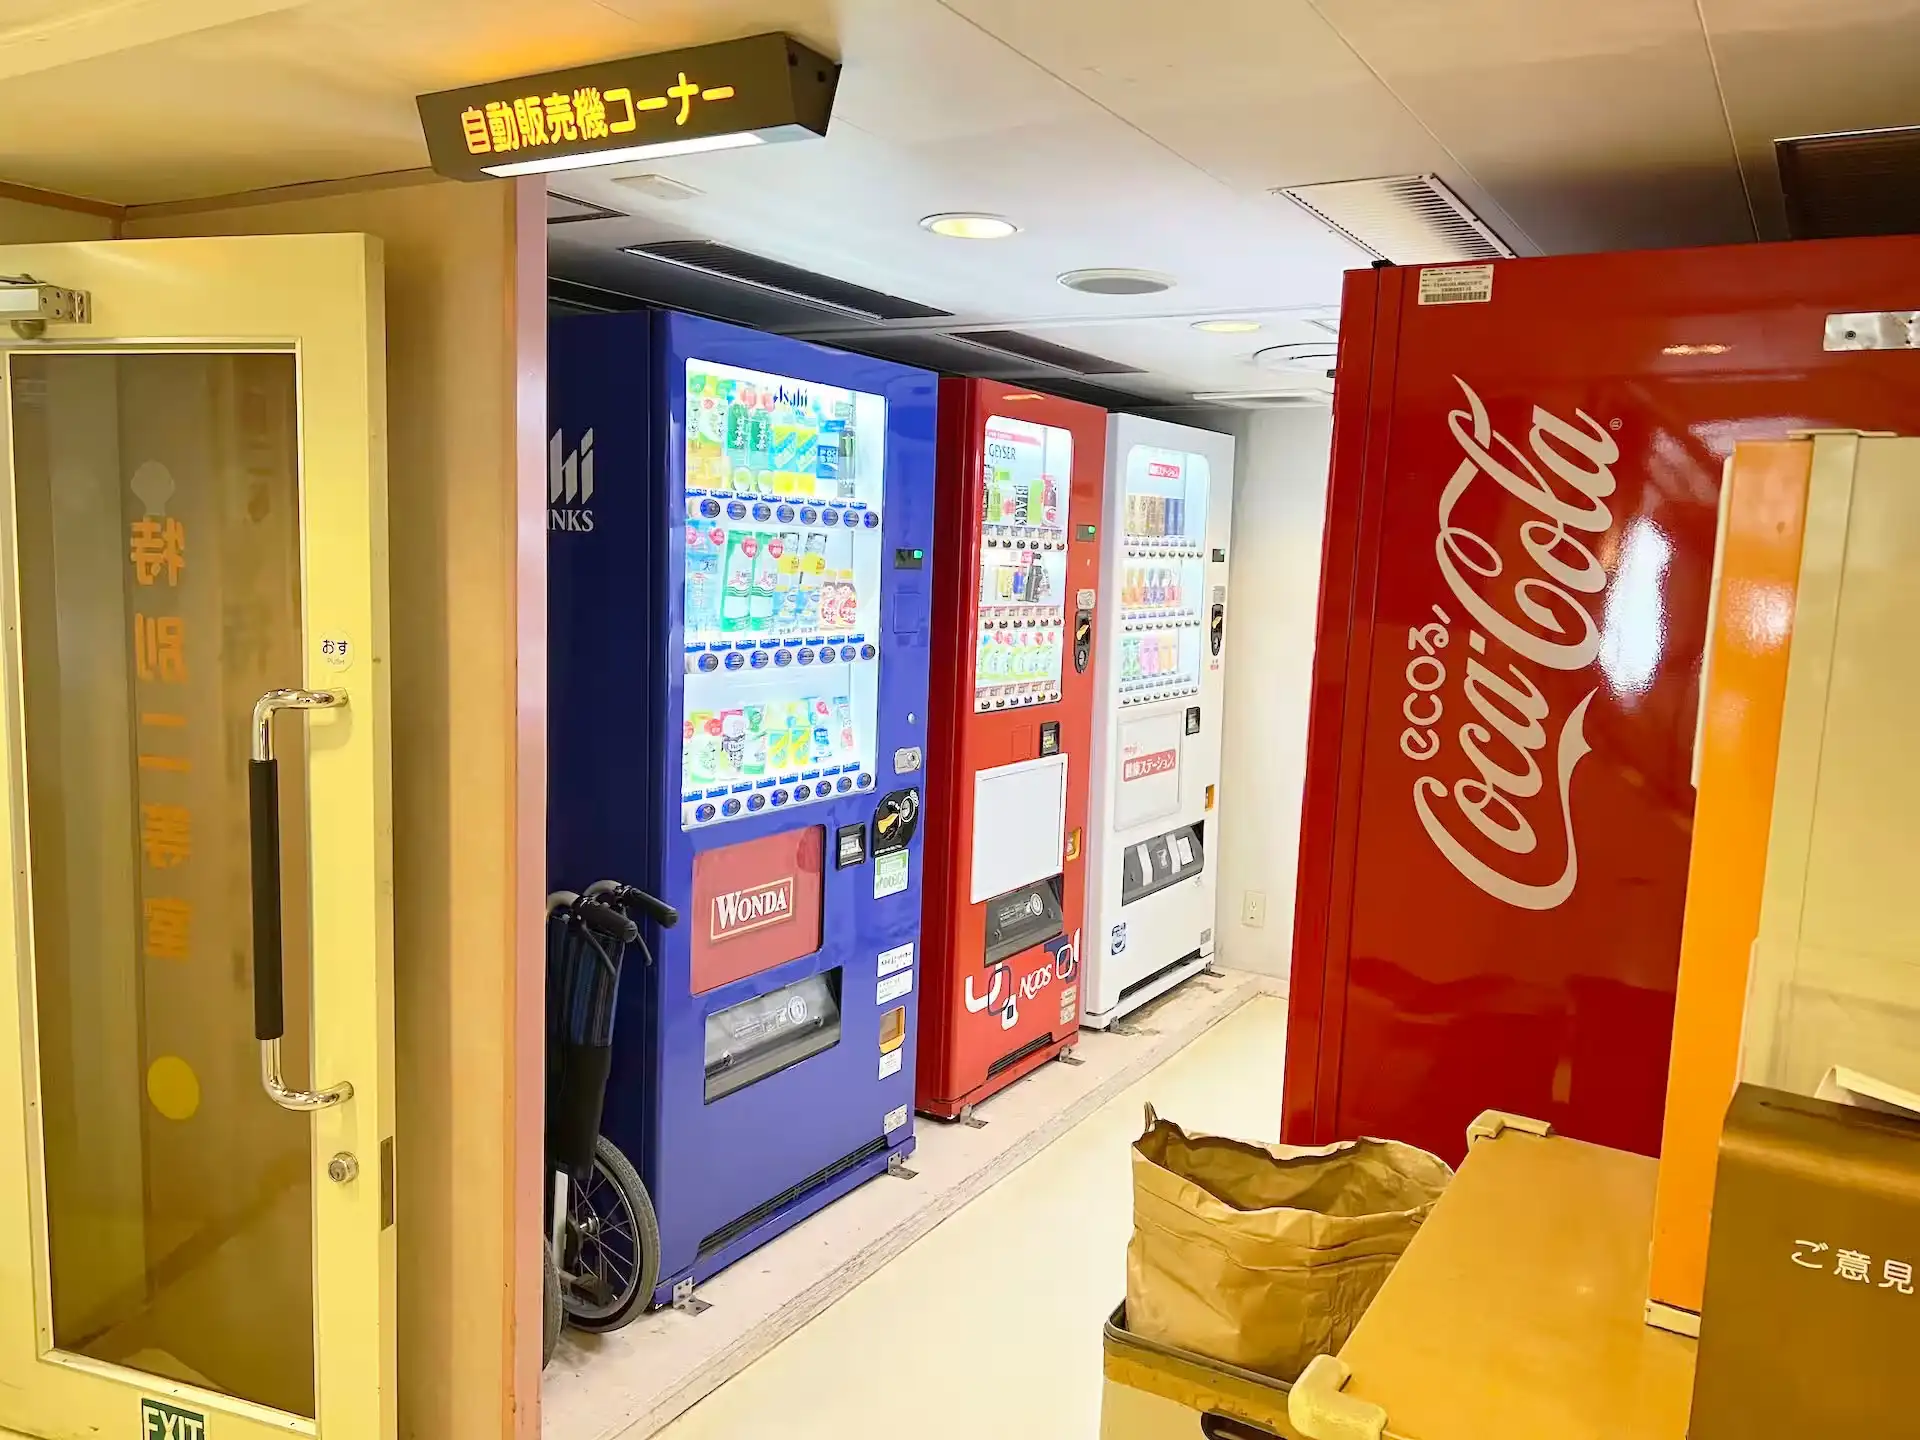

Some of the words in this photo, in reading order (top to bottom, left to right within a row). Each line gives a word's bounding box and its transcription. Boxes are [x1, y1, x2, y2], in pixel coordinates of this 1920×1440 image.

[461, 72, 735, 154] 自動販売機コーナー
[322, 639, 348, 655] おす
[1413, 374, 1621, 911] Coca-Cola
[1791, 1239, 1914, 1295] ご意見
[142, 1405, 204, 1440] EXIT
